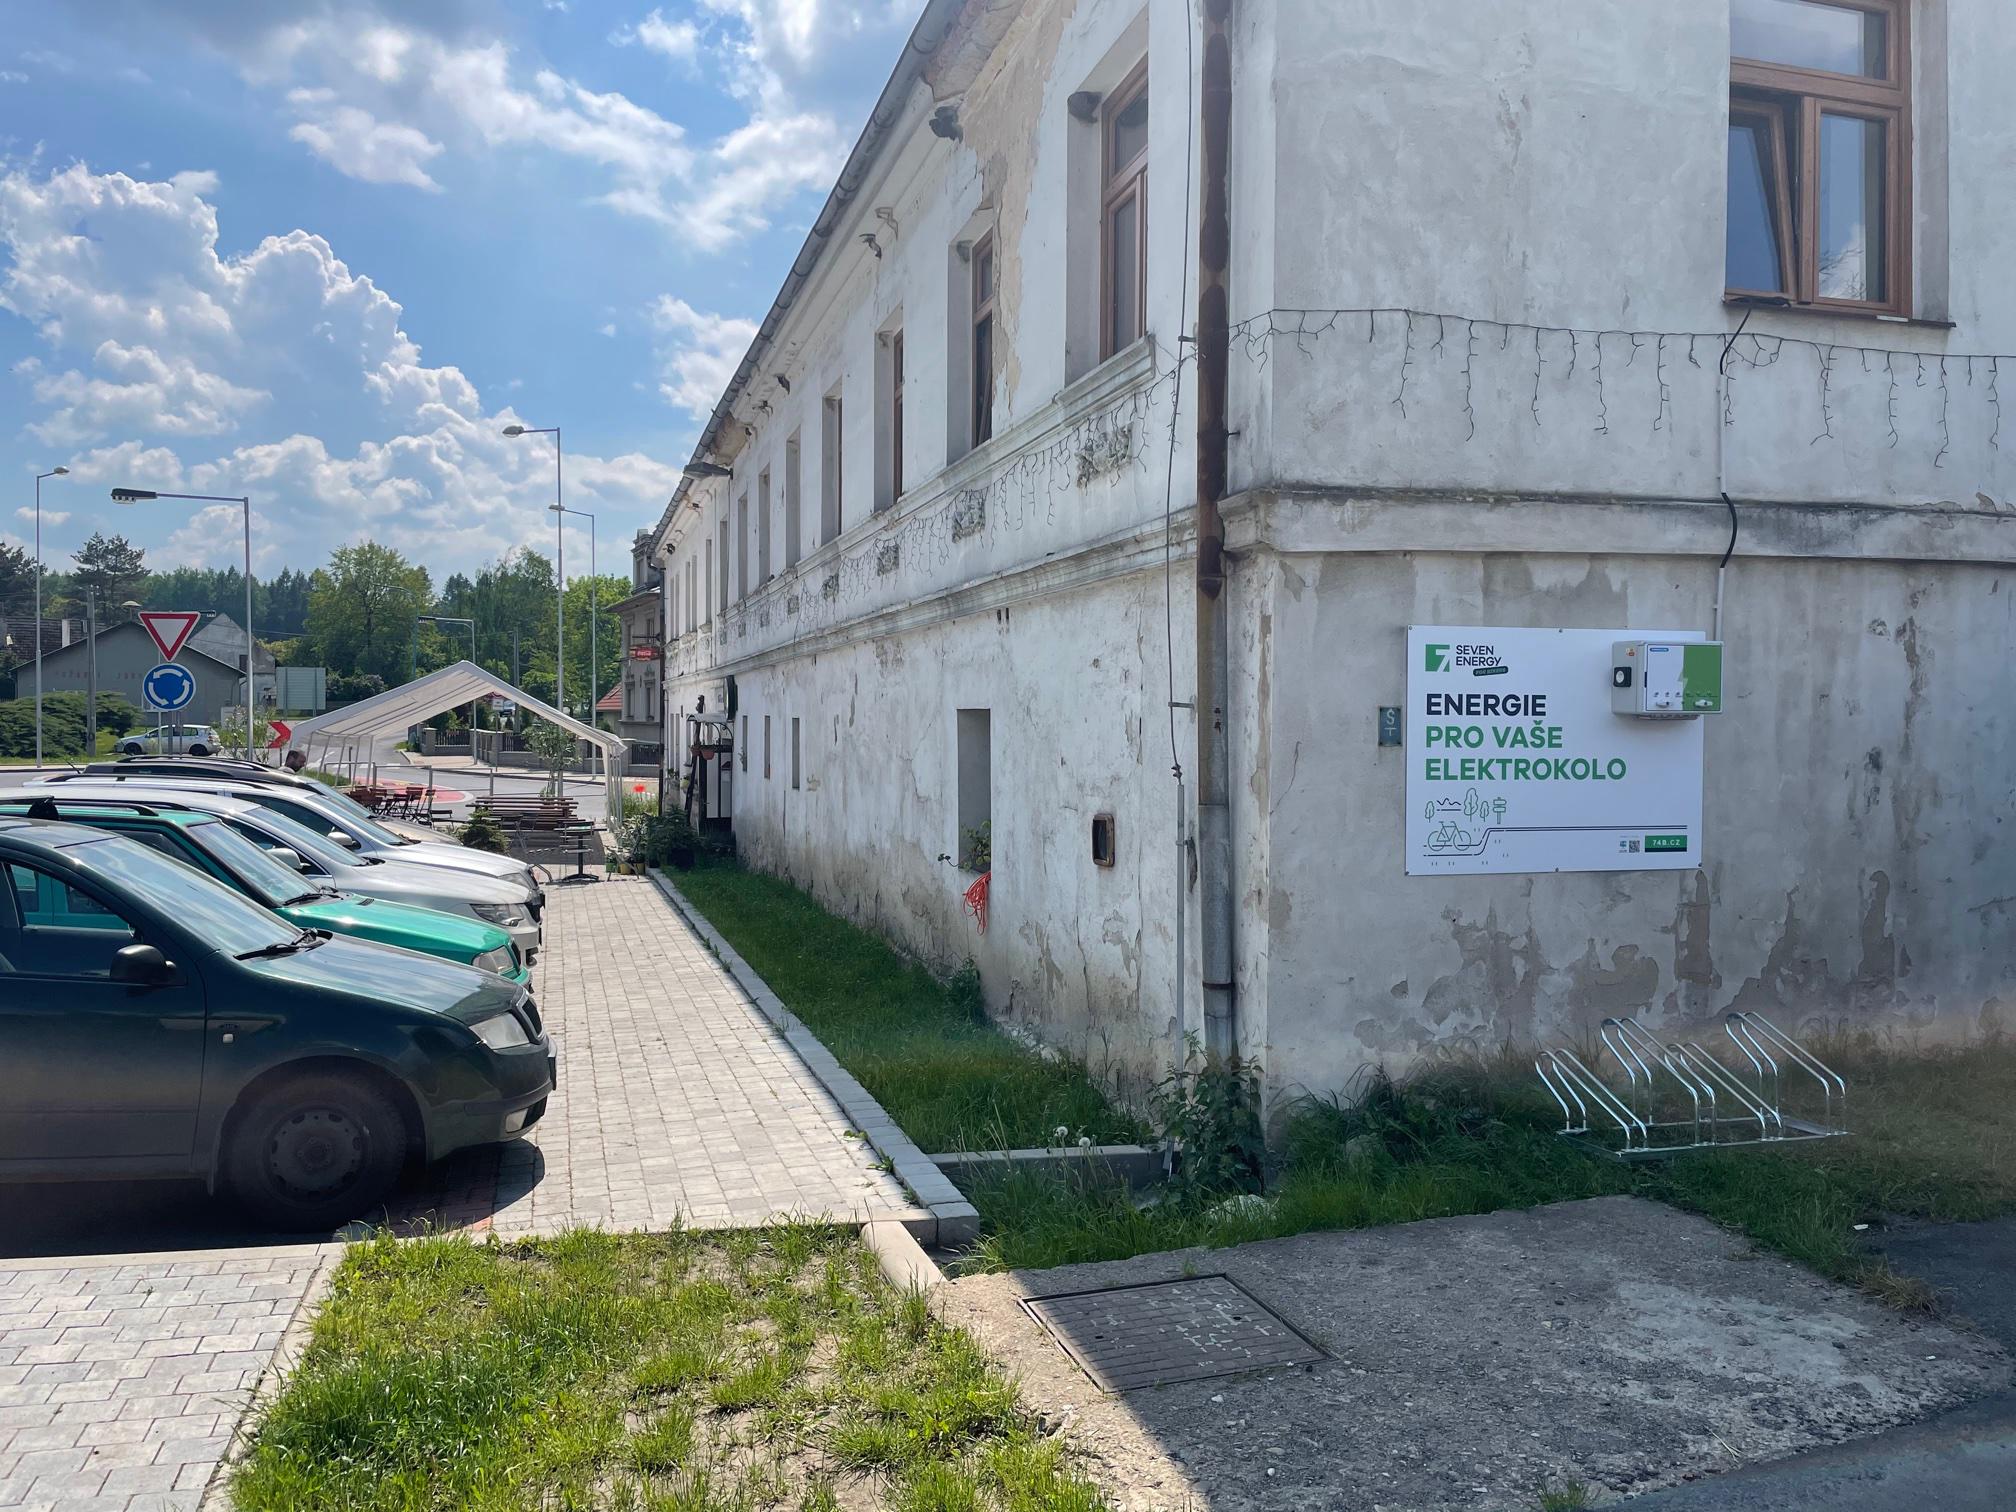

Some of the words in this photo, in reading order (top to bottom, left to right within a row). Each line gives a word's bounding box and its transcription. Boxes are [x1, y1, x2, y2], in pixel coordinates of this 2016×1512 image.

[1456, 656, 1502, 666] ENERGY
[1426, 693, 1547, 717] ENERGIE
[1426, 725, 1484, 749] PRO
[1491, 720, 1563, 749] VAŠE
[1425, 758, 1627, 781] ELEKTROKOLO
